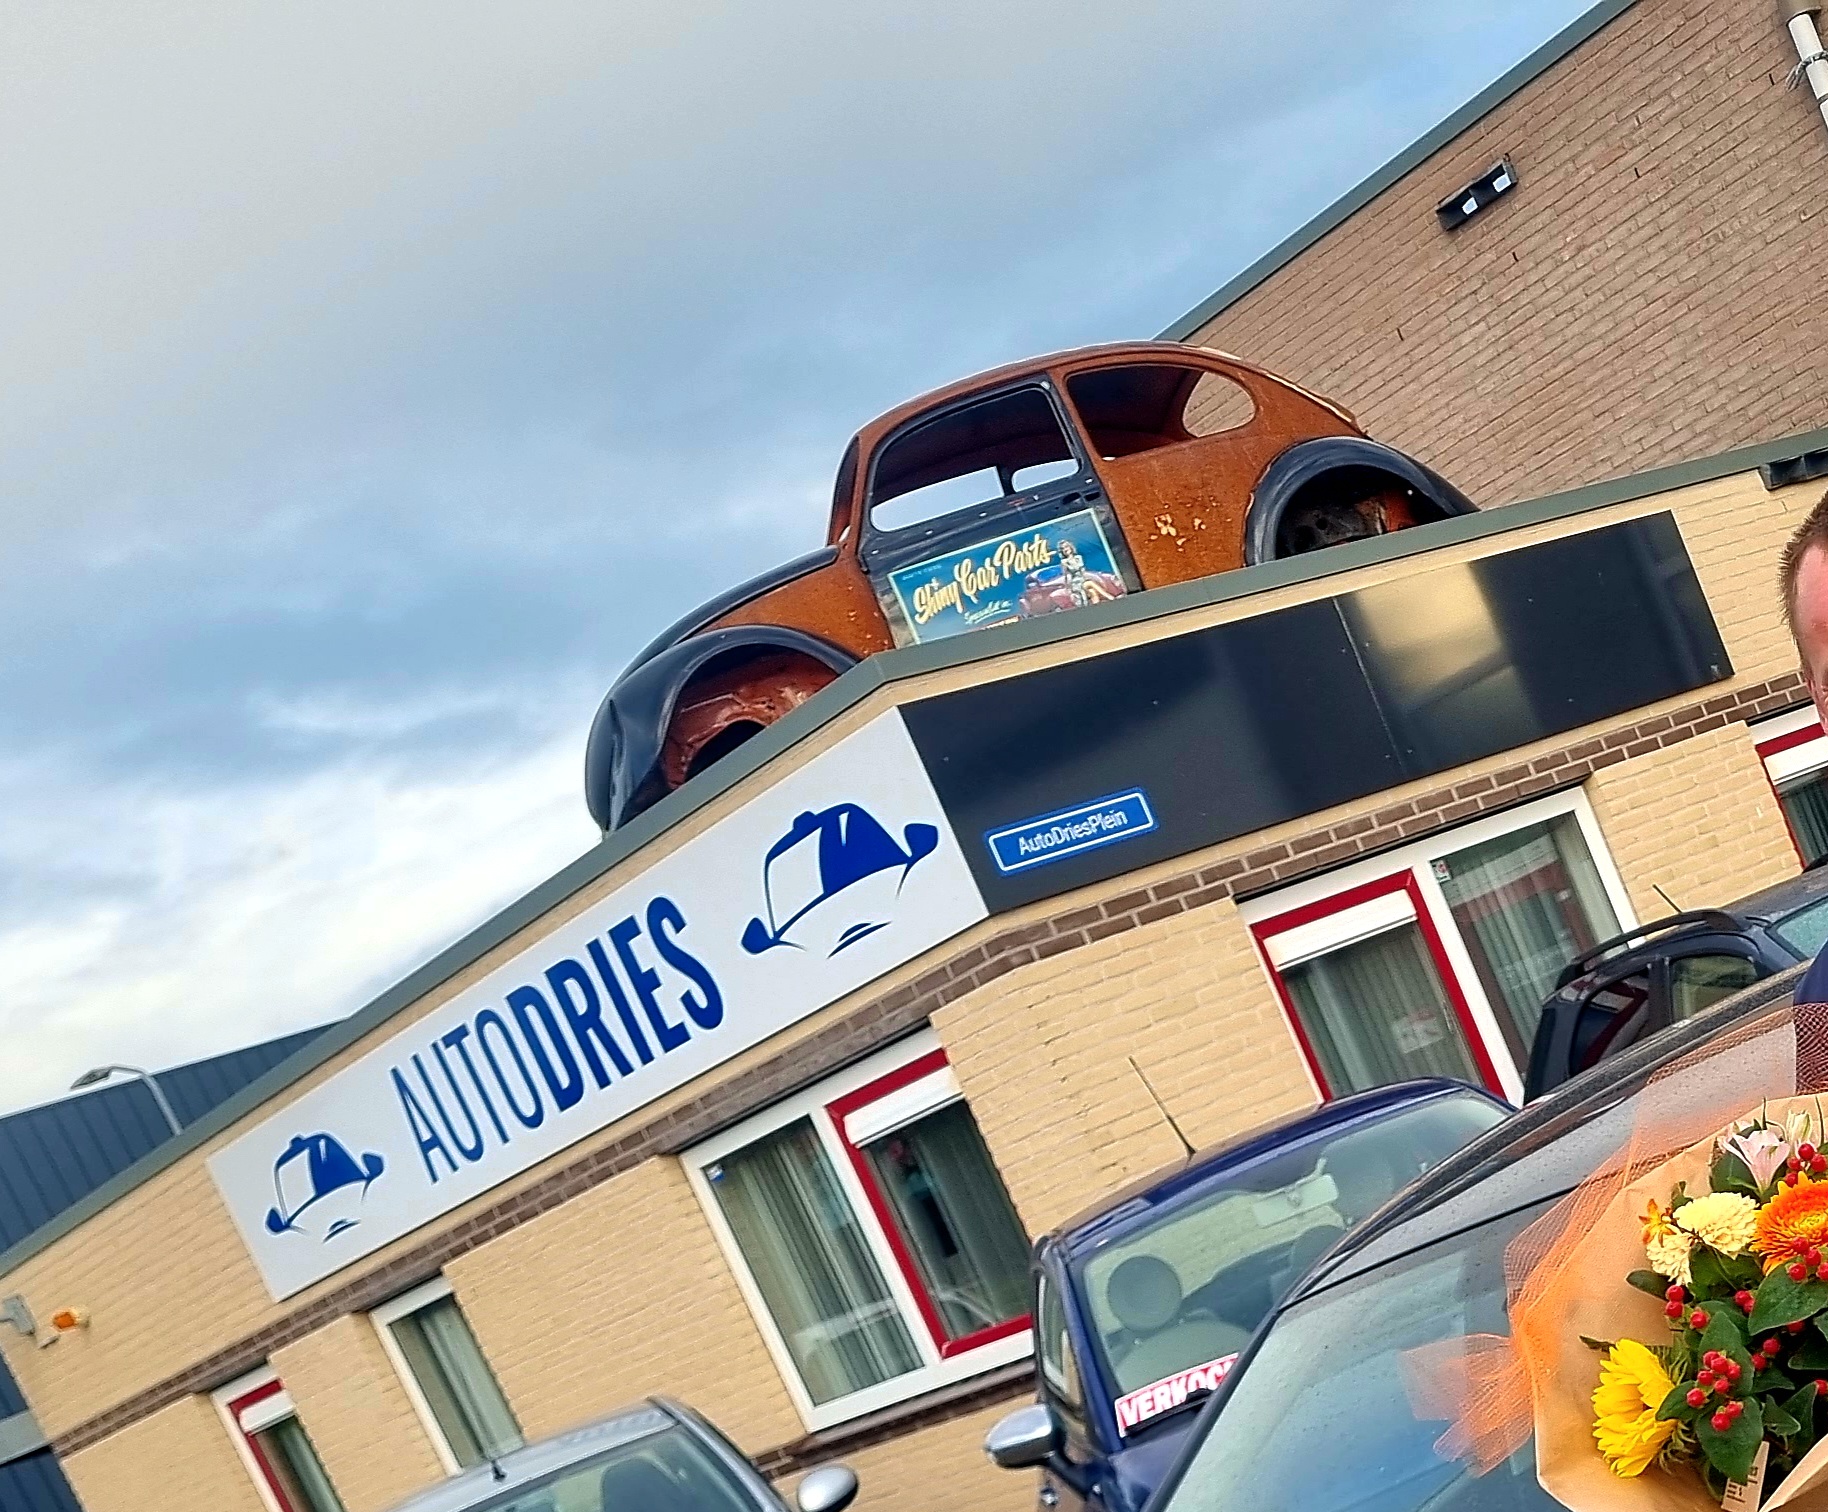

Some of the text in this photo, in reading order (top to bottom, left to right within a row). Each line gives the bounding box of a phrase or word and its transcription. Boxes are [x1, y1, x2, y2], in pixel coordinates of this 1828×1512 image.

[913, 577, 964, 625] Shiny
[954, 558, 999, 604] Car
[993, 533, 1058, 580] Parts
[1018, 808, 1128, 855] AutoDriesPlein
[389, 896, 726, 1184] AUTODRIES
